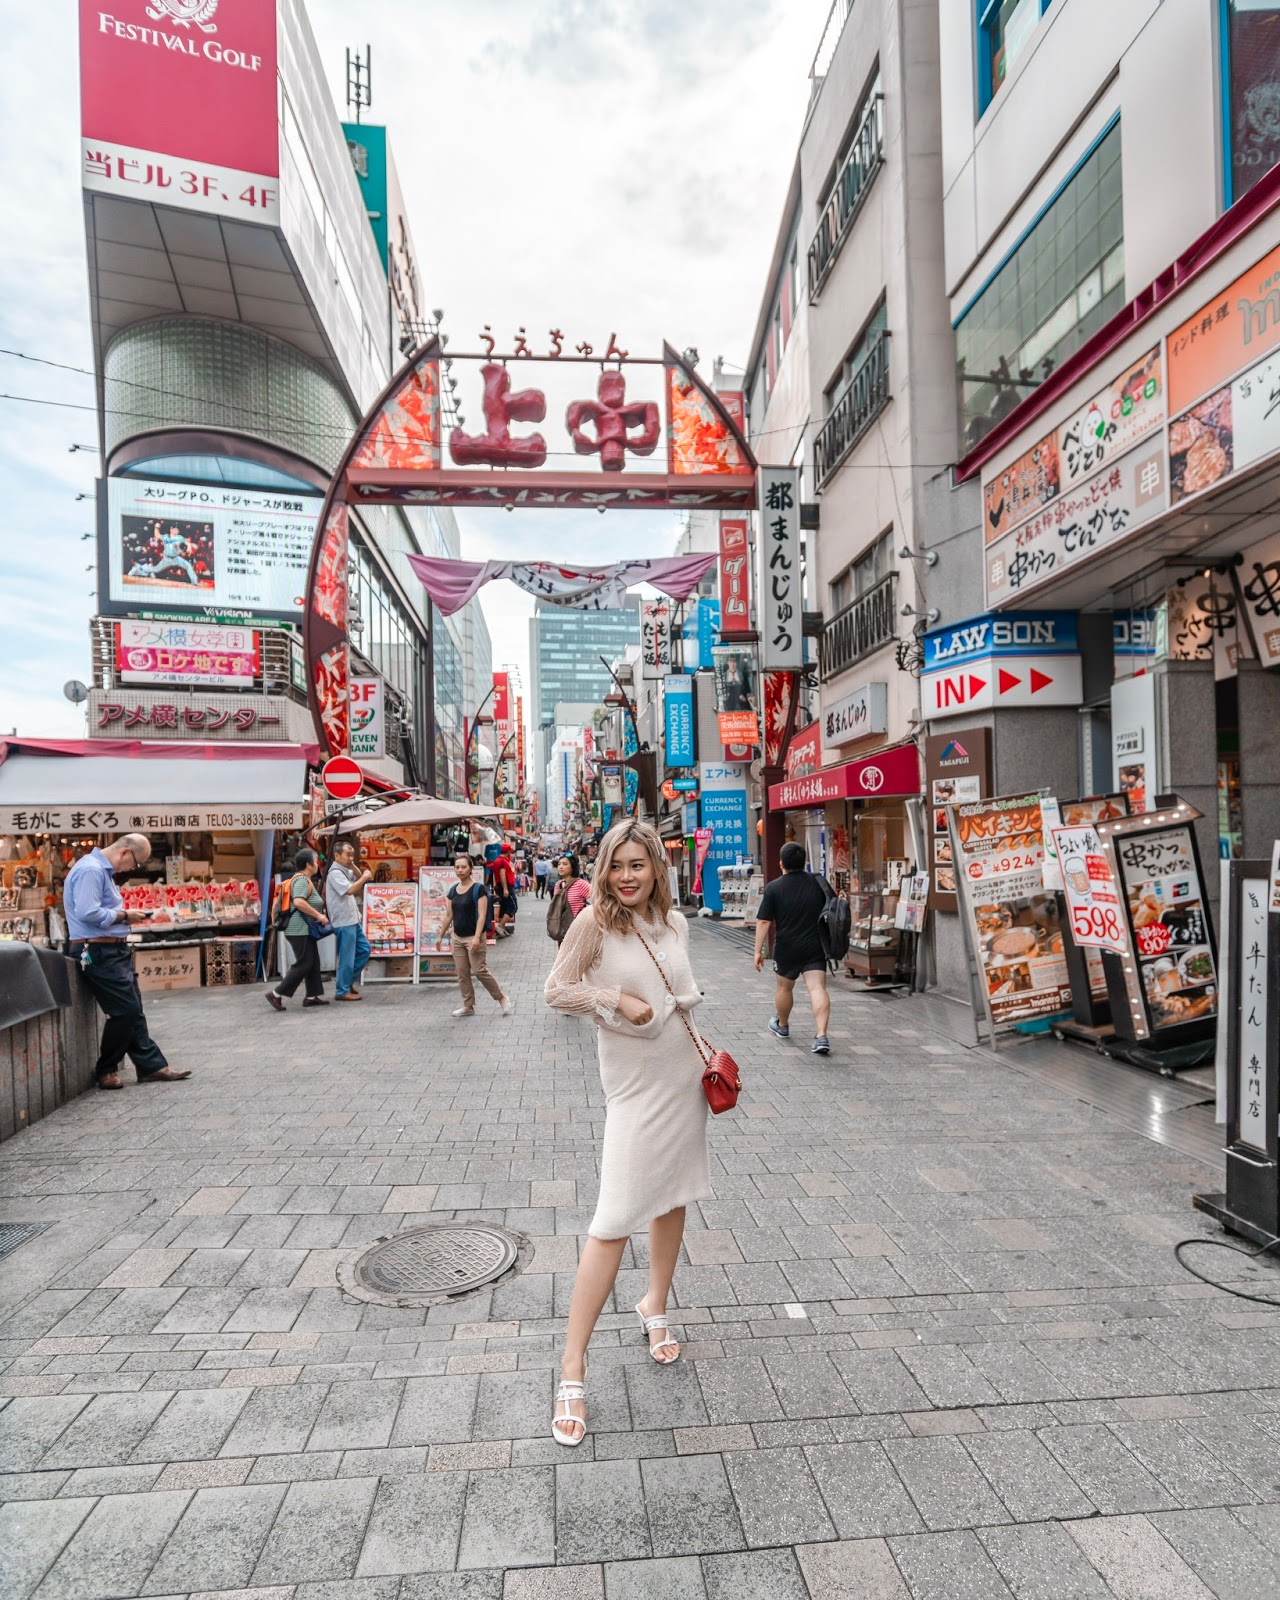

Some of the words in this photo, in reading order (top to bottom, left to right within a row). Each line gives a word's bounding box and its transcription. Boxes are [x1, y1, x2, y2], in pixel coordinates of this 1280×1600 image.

[98, 12, 200, 57] FESTIVAL
[203, 40, 262, 72] GOLF
[85, 149, 172, 188] 当ビル
[479, 325, 629, 359] うえちゅん
[1171, 301, 1231, 357] インド料理
[1140, 460, 1161, 496] 串
[1058, 500, 1131, 553] でんがな
[764, 481, 795, 652] 都まんじゅう
[991, 559, 1005, 585] 串
[1008, 549, 1056, 588] 串かつ
[723, 554, 746, 615] ゲーム
[657, 621, 671, 667] もつ焼
[152, 673, 225, 683] アメ横センタービル
[156, 653, 246, 672] ロケ地です
[936, 675, 965, 708] IN
[97, 703, 280, 730] アメ横センター
[669, 703, 680, 757] EXCHANGE
[680, 703, 690, 757] CURRENCY
[826, 699, 868, 738] 都まんじゅう
[351, 734, 378, 743] EVEN
[705, 768, 743, 779] エアトリ
[939, 756, 970, 767] NAGAFUJI
[704, 796, 743, 805] CURRENCY
[704, 804, 743, 812] EXCHANGE
[12, 811, 61, 830] 毛がに
[71, 811, 119, 829] まぐろ
[993, 855, 1035, 872] ¥924
[1122, 842, 1180, 869] 串かつ
[1073, 906, 1120, 942] 598
[1143, 936, 1164, 954] 90
[1246, 950, 1266, 1027] 牛たん
[1247, 1053, 1262, 1118] 専門店
